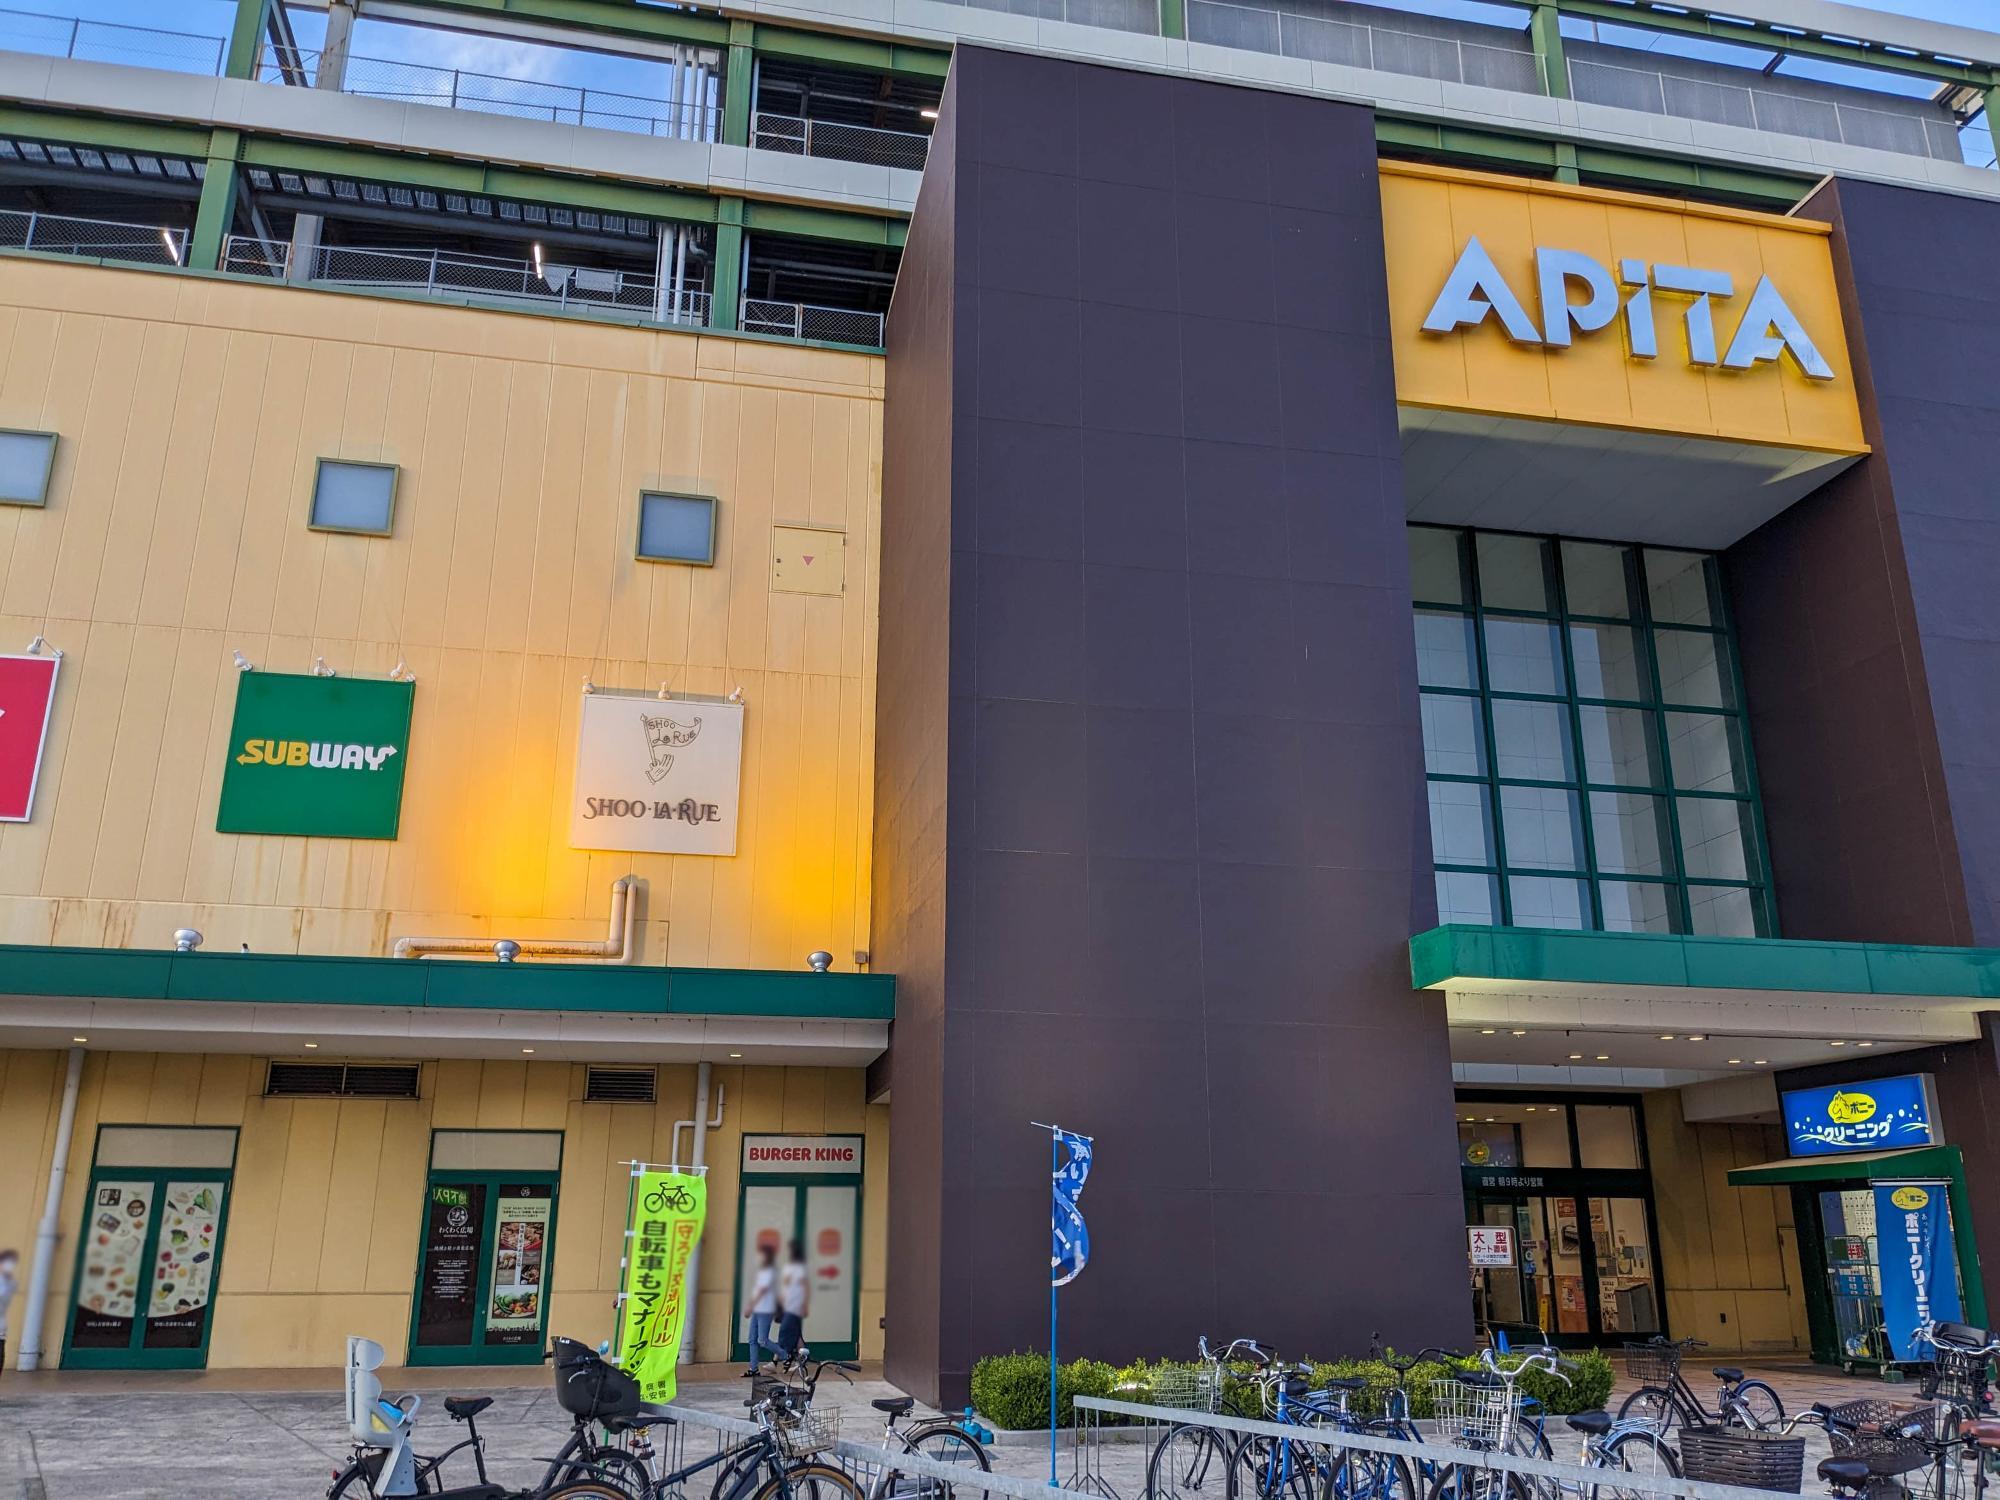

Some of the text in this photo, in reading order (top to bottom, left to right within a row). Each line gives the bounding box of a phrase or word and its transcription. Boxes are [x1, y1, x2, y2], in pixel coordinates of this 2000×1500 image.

[648, 720, 676, 730] SHOO
[236, 739, 398, 771] SUBWAY
[1824, 1113, 1893, 1142] クリーニング
[749, 1147, 854, 1162] BURGER KING
